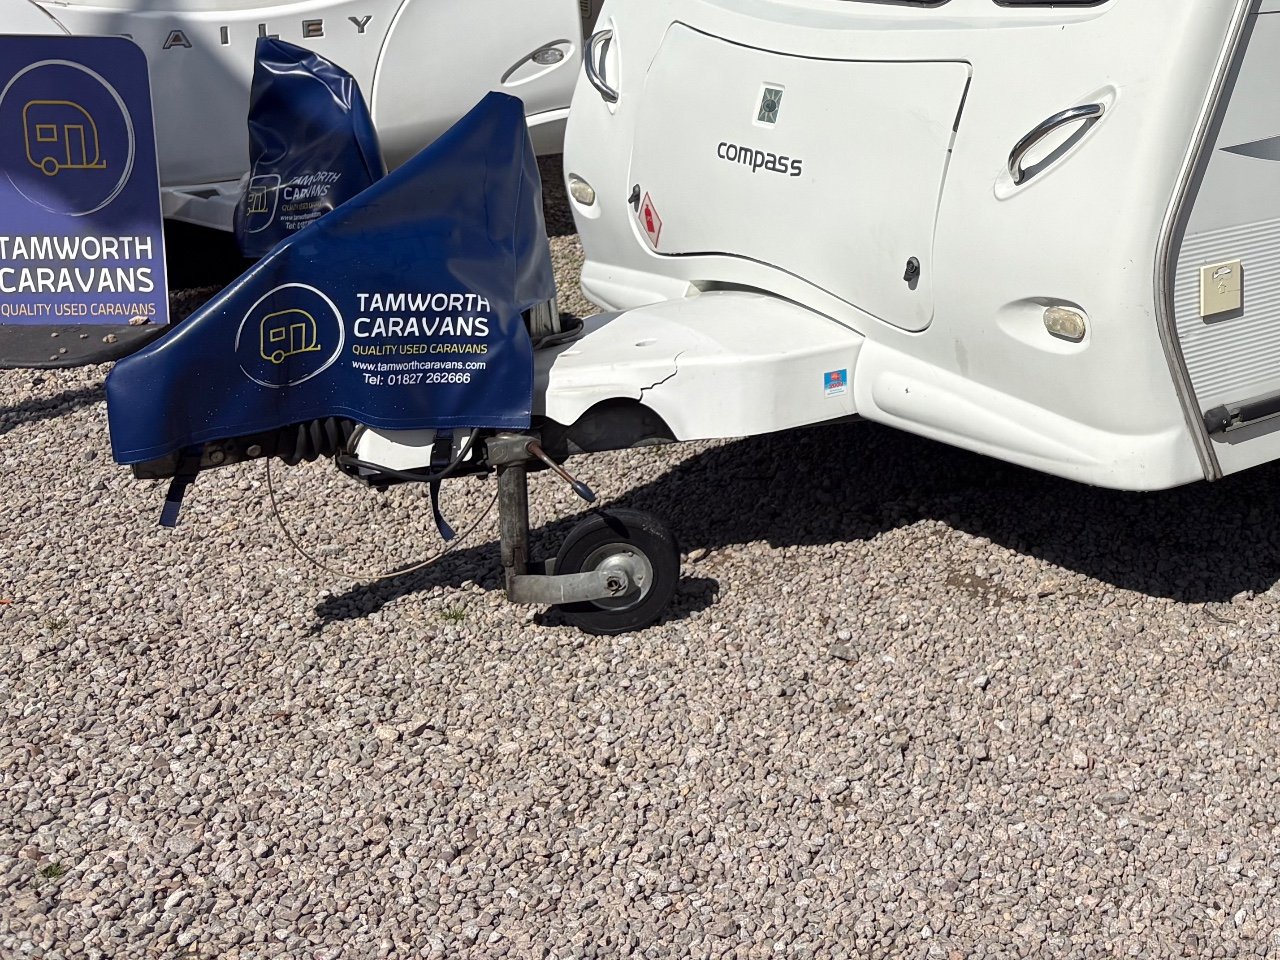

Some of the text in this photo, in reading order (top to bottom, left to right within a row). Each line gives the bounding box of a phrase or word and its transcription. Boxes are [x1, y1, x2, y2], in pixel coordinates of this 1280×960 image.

[118, 15, 373, 50] AILEY
[717, 142, 803, 177] compass
[0, 236, 153, 260] TAMWORTH
[0, 267, 154, 293] CARAVANS
[1, 302, 156, 317] QUALITY USED CARAVANS
[357, 293, 491, 312] TAMWORTH
[353, 316, 490, 337] CARAVANS
[352, 343, 488, 355] QUALITY USED CARAVANS
[352, 360, 486, 371] www.tamworthcaravans.com
[363, 372, 471, 386] Tel: 01827 262666
